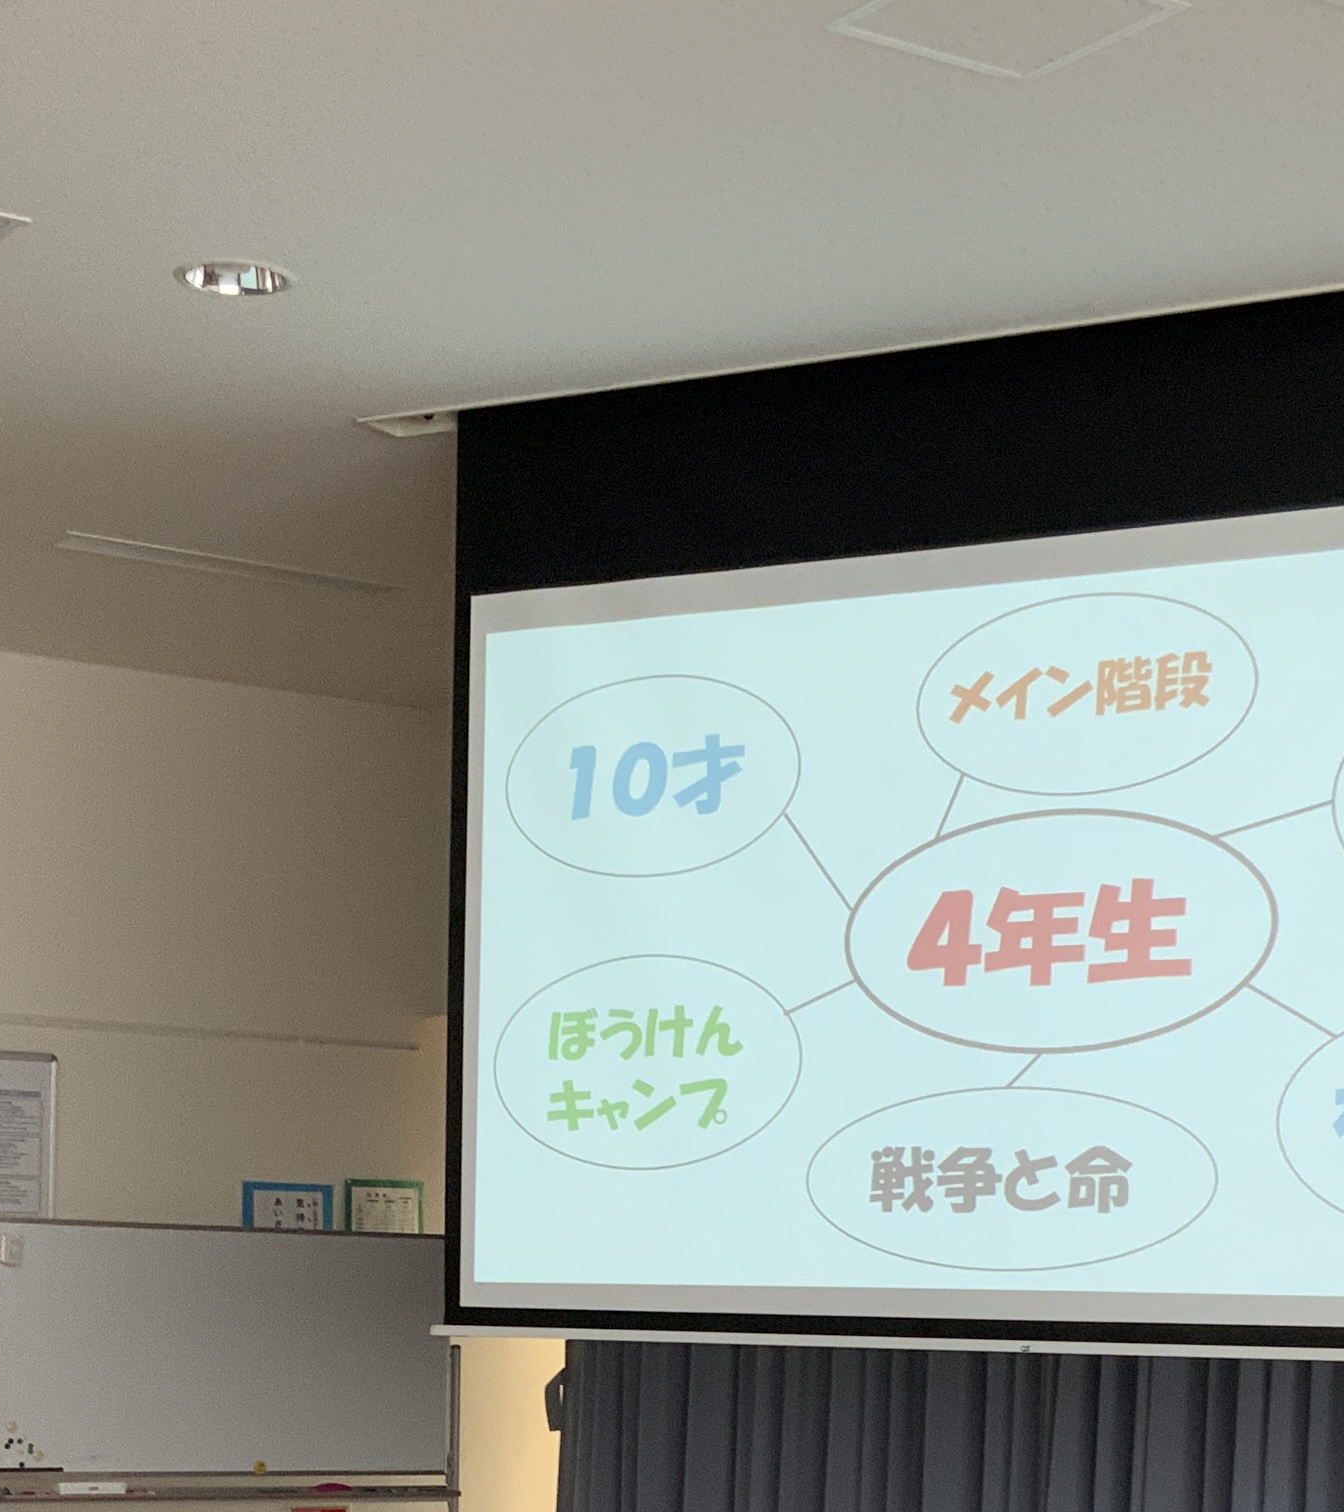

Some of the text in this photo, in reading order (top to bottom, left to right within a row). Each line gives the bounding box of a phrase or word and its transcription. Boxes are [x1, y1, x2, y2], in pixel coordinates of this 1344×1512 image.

[949, 650, 1213, 725] メイン階段
[569, 734, 745, 820] 10才
[906, 877, 1193, 987] 4年生
[547, 1004, 743, 1062] ぼうけん
[546, 1078, 729, 1132] キャンプ
[868, 1145, 1133, 1214] 戦争と命
